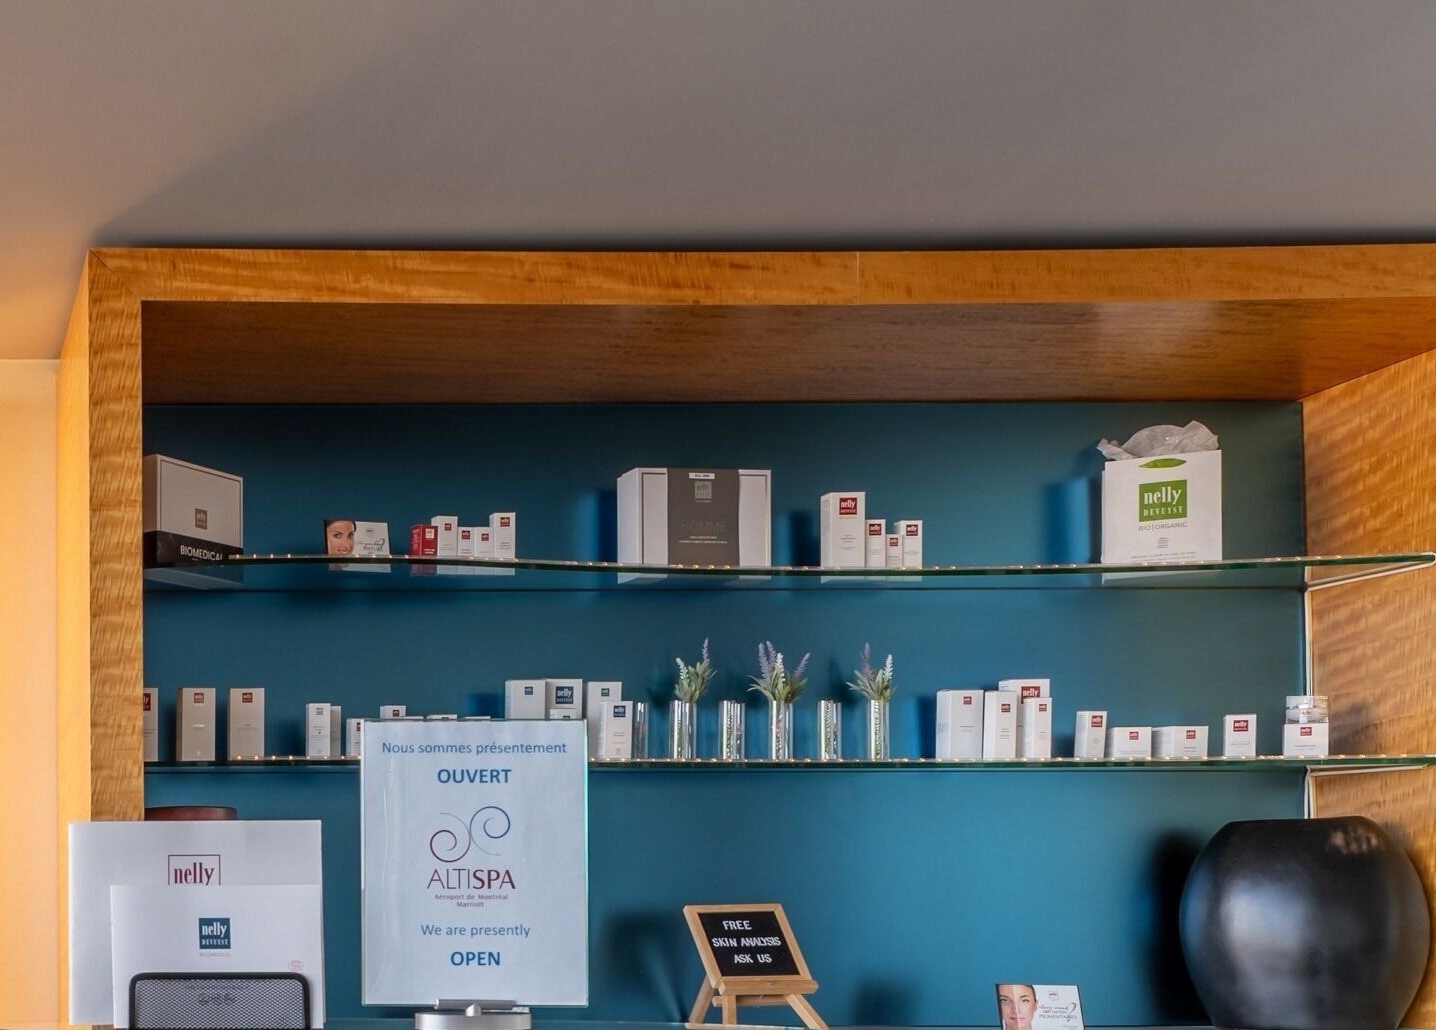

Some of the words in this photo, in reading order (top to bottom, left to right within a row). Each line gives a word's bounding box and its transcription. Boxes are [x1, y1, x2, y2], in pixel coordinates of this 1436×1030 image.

[1144, 486, 1182, 505] nelly
[840, 500, 857, 509] nelly
[557, 687, 573, 698] nelly
[382, 742, 414, 754] Nous
[418, 744, 472, 754] sommes
[476, 742, 567, 756] présentement
[437, 769, 512, 784] OUVERT
[174, 862, 215, 886] nelly
[427, 868, 516, 890] ALTISPA
[201, 921, 227, 938] nelly
[420, 924, 442, 936] We
[445, 926, 466, 936] are
[470, 923, 531, 939] presently
[722, 920, 752, 930] FREE
[712, 937, 738, 947] SKIN
[741, 936, 782, 947] ANALYSIS
[450, 951, 501, 966] OPEN
[734, 953, 754, 964] ASK
[756, 953, 773, 964] US
